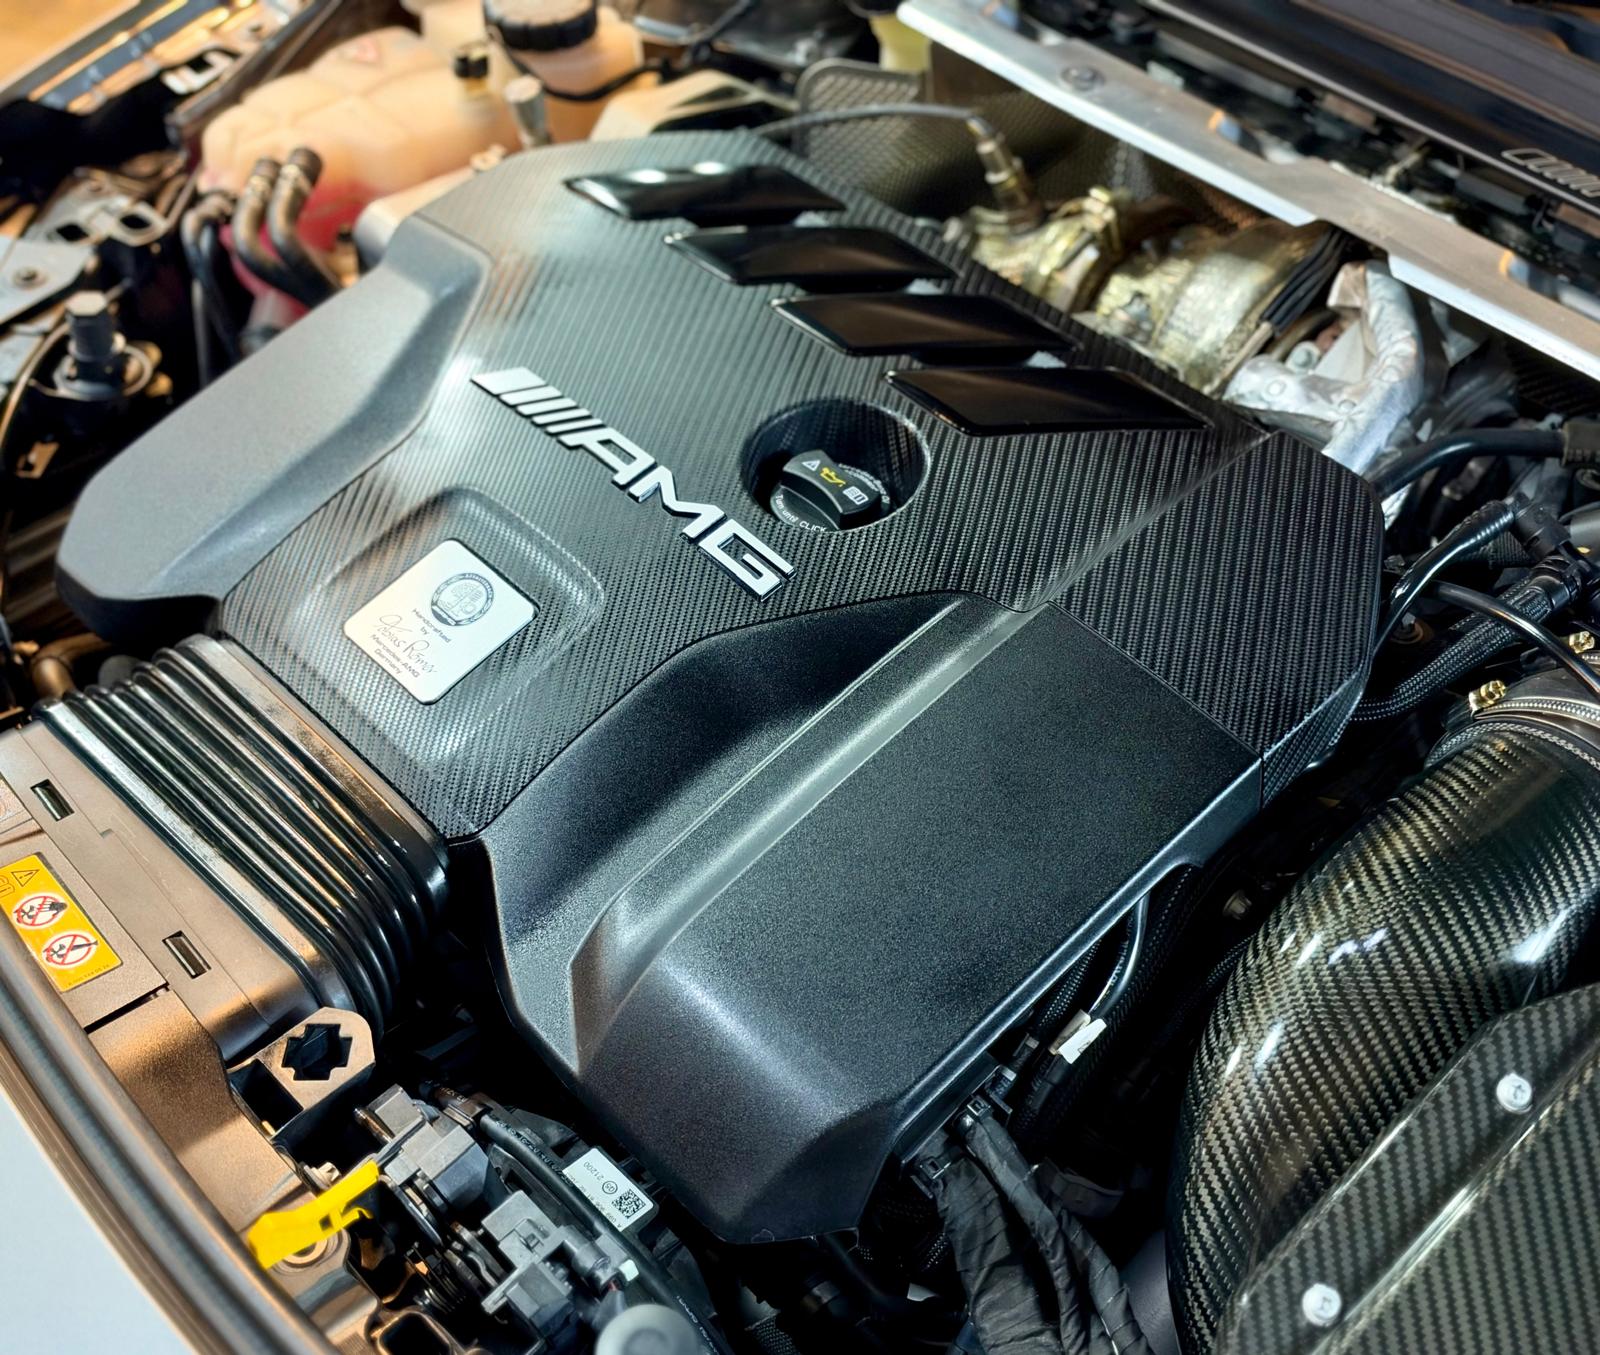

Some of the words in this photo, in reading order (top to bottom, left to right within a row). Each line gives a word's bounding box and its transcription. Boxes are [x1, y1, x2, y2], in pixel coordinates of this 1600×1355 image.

[556, 427, 797, 602] AMG
[775, 494, 785, 510] Turn
[799, 520, 827, 532] CLICK
[411, 608, 452, 643] Handcrafted
[420, 626, 430, 635] by
[370, 633, 421, 678] Mercedes-AMG
[374, 648, 402, 674] Germany
